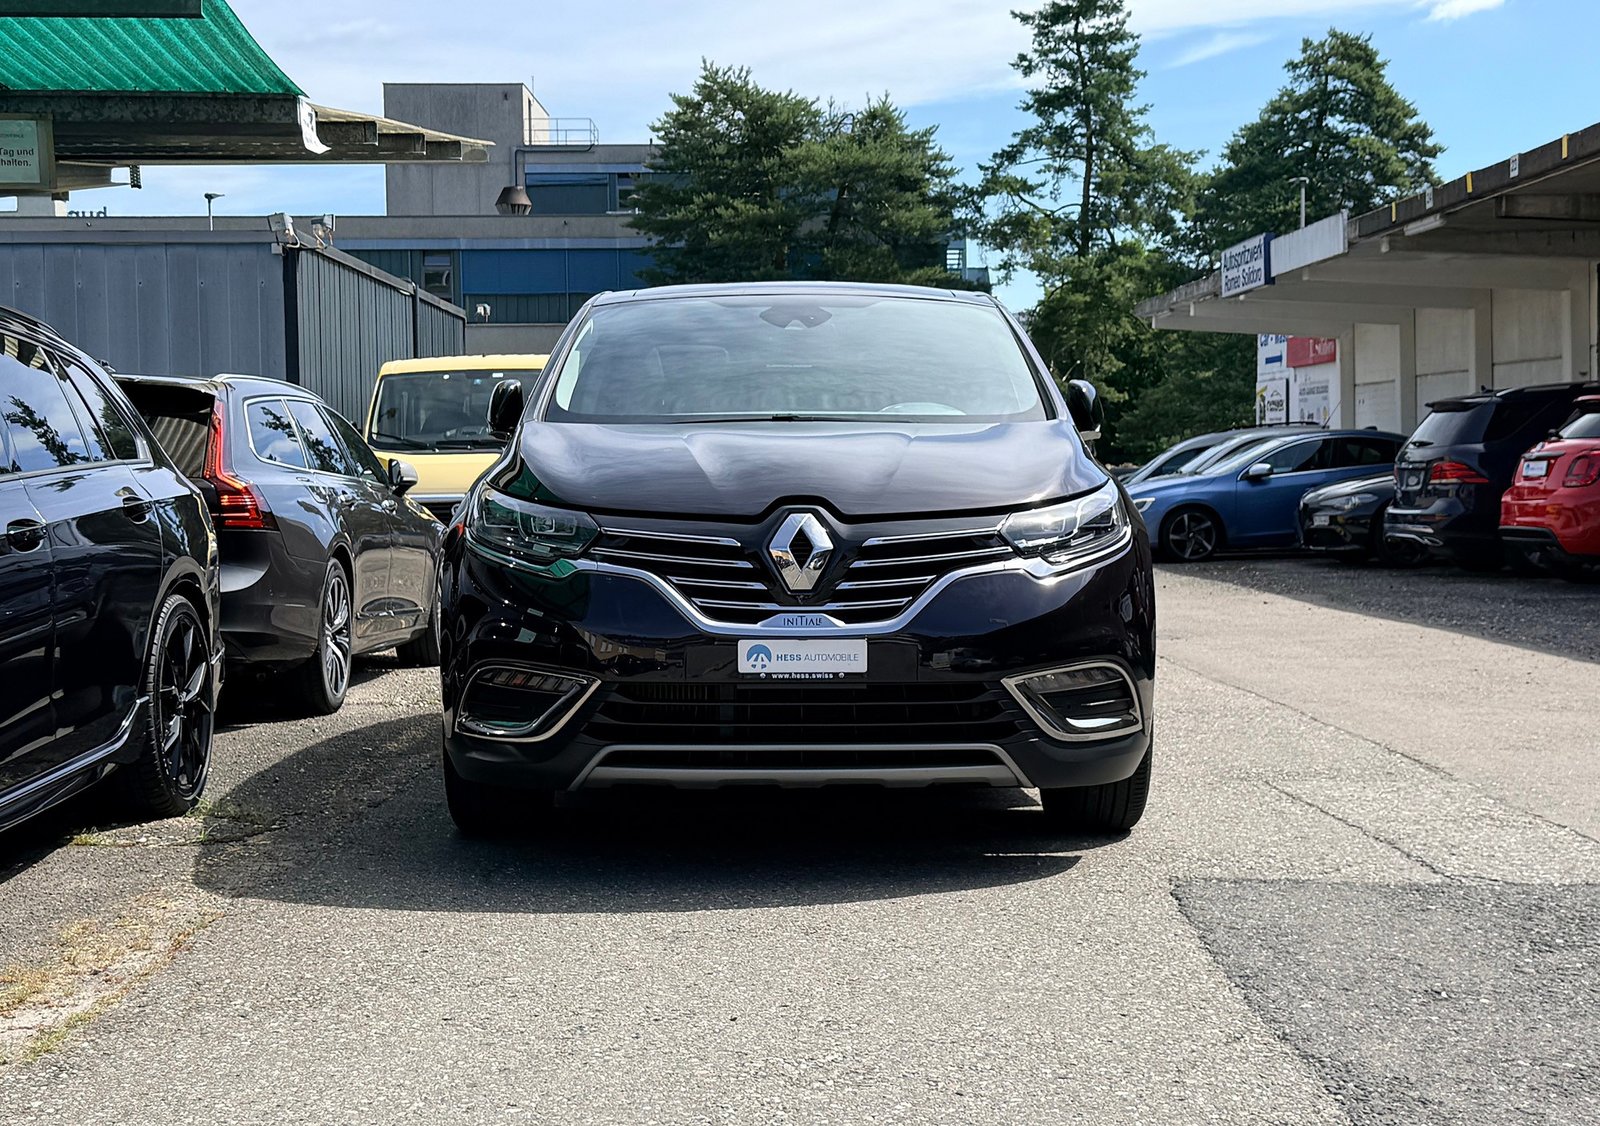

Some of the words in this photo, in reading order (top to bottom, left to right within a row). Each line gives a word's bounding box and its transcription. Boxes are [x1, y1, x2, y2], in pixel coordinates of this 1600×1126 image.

[17, 147, 34, 156] und
[1223, 239, 1263, 273] Autospritzwerk
[1224, 275, 1241, 292] Romeo
[783, 615, 822, 626] INITIALE
[776, 653, 801, 662] HESS
[803, 653, 859, 662] AUTOMOBILE
